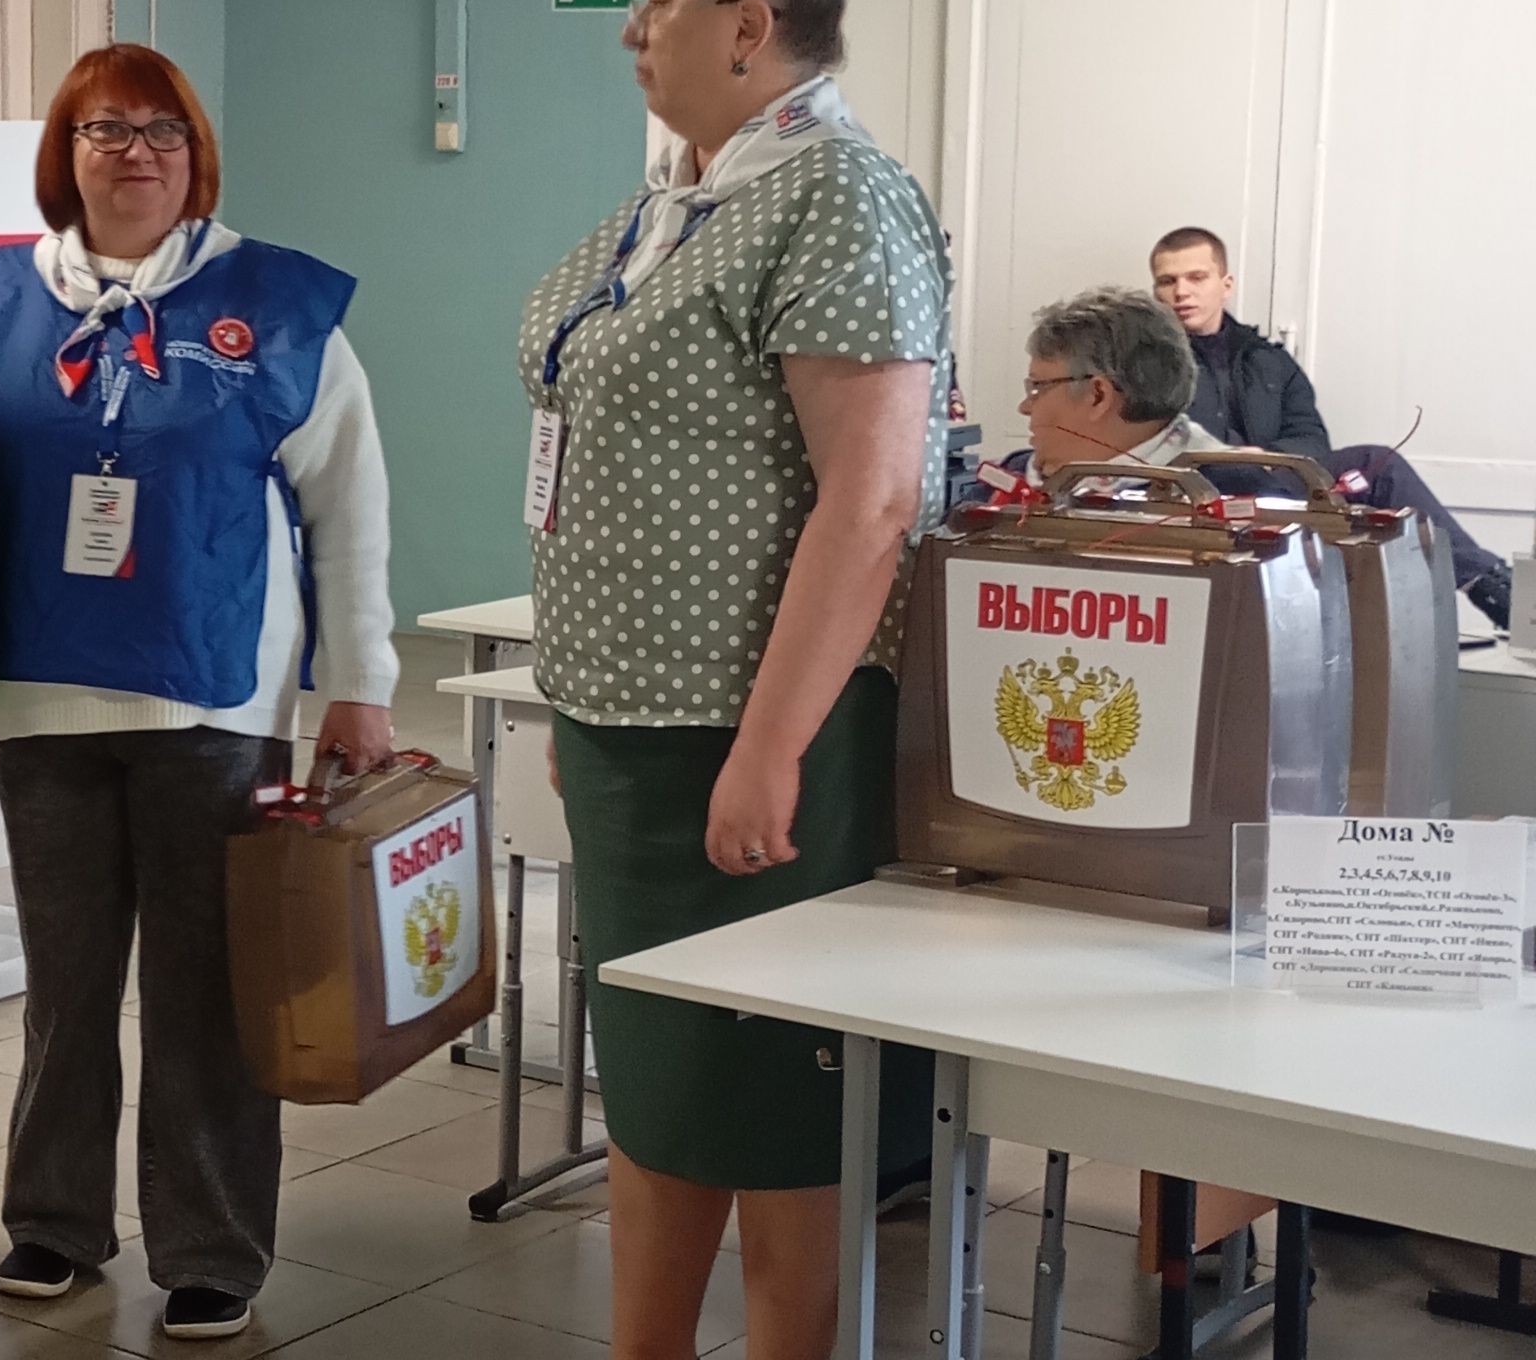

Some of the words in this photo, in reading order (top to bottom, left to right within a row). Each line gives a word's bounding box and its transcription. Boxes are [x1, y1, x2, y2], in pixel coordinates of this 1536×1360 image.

[977, 582, 1168, 645] ВЫБОРЫ
[388, 816, 464, 889] ВЫБОРЫ
[1337, 819, 1413, 844] Дома
[1421, 822, 1455, 843] №
[1339, 866, 1452, 883] 2,3,4,5,6,7,8,9,10
